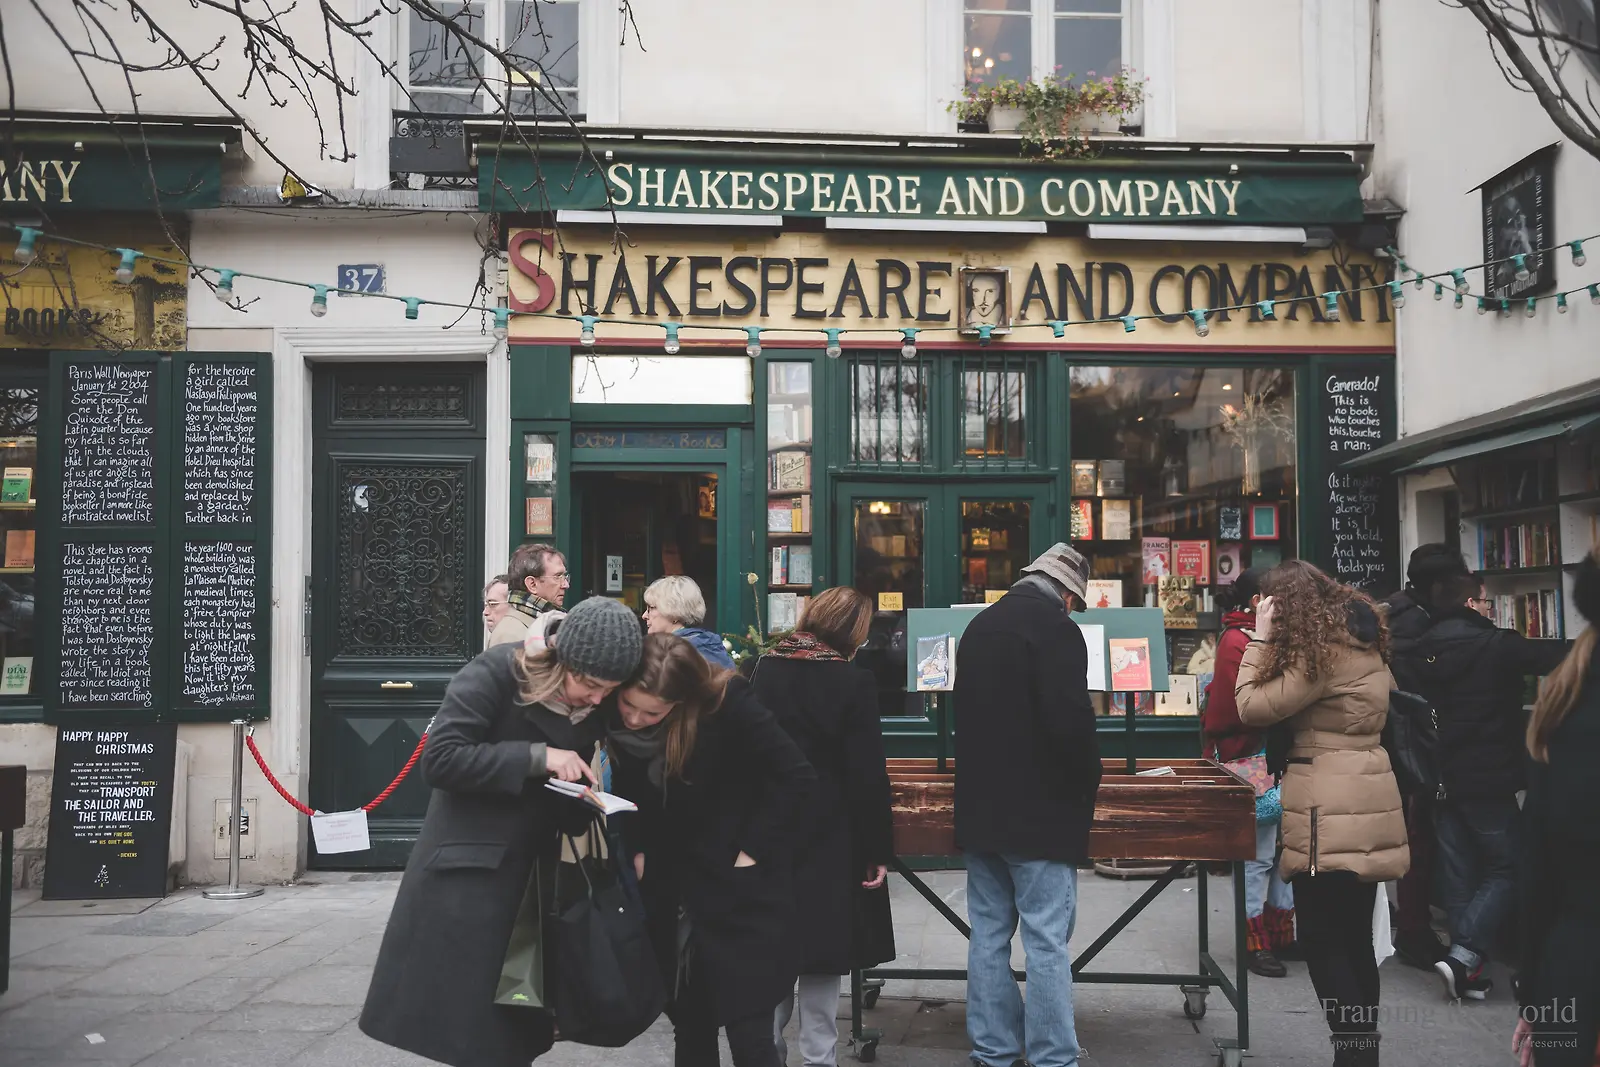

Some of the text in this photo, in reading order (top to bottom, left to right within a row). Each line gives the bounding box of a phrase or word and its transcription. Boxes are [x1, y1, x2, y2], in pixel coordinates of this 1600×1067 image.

[608, 163, 1242, 216] SHAKESPEARE AND COMPANY
[344, 268, 378, 292] 37
[508, 230, 1394, 323] SHAKESPEARE AND COMPANY
[69, 365, 152, 382] Paris Wall Newspaper
[223, 364, 255, 376] heroine
[72, 379, 105, 396] January
[120, 380, 149, 392] 2004
[195, 376, 248, 389] girl called
[1326, 376, 1380, 393] Camerado!
[71, 393, 130, 407] Some people
[1331, 395, 1368, 406] This is
[118, 404, 138, 414] Don
[186, 401, 256, 416] One hundred years
[68, 413, 110, 425] Quixote
[218, 413, 256, 423] bookstore
[1348, 416, 1380, 426] touches
[66, 423, 153, 436] Latin quarter because
[234, 423, 253, 436] shop
[1349, 427, 1380, 438] touches
[81, 434, 104, 445] head
[185, 432, 207, 442] hidden
[117, 446, 149, 456] clouds
[110, 457, 139, 470] imagine
[185, 454, 254, 468] Hotel Dieu hospital
[106, 467, 137, 481] angels
[186, 467, 211, 477] which
[122, 479, 153, 488] instead
[205, 479, 254, 490] demolished
[1342, 474, 1350, 487] it
[74, 490, 96, 502] being
[202, 490, 239, 502] replaced
[1329, 491, 1344, 503] Are
[63, 500, 99, 510] bookseller
[69, 510, 114, 524] frustrated
[185, 511, 238, 523] Further back
[1332, 517, 1358, 530] It is
[1335, 534, 1353, 545] you
[64, 544, 85, 555] This
[88, 544, 106, 556] store
[199, 542, 232, 554] year 1600
[1332, 544, 1379, 558] And who
[86, 555, 125, 567] chapters
[185, 553, 237, 567] whole building
[1337, 559, 1363, 573] holds
[64, 565, 140, 575] novel fact
[191, 563, 254, 577] monastery called
[62, 575, 94, 589] Tolstoy
[108, 586, 124, 595] real
[195, 586, 253, 597] medieval times
[103, 596, 122, 604] next
[202, 597, 239, 610] monastery
[63, 606, 105, 619] neighbors
[62, 615, 99, 628] stranger
[184, 617, 232, 632] whose duty
[128, 624, 153, 635] before
[87, 634, 104, 644] born
[195, 629, 256, 644] light lamps
[62, 645, 135, 658] wrote story
[79, 656, 150, 669] life book
[230, 653, 254, 666] doing
[61, 668, 86, 677] called
[214, 663, 232, 676] fifty
[107, 679, 140, 691] reading
[185, 674, 204, 684] Now
[233, 682, 254, 692] turn.
[111, 690, 152, 707] searching
[97, 732, 128, 742] HAPPY
[96, 744, 154, 754] CHRISTMAS
[100, 787, 155, 797] TRANSPORT
[65, 799, 144, 810] THE SAILOR AND
[78, 810, 156, 822] THE TRAVELLER,
